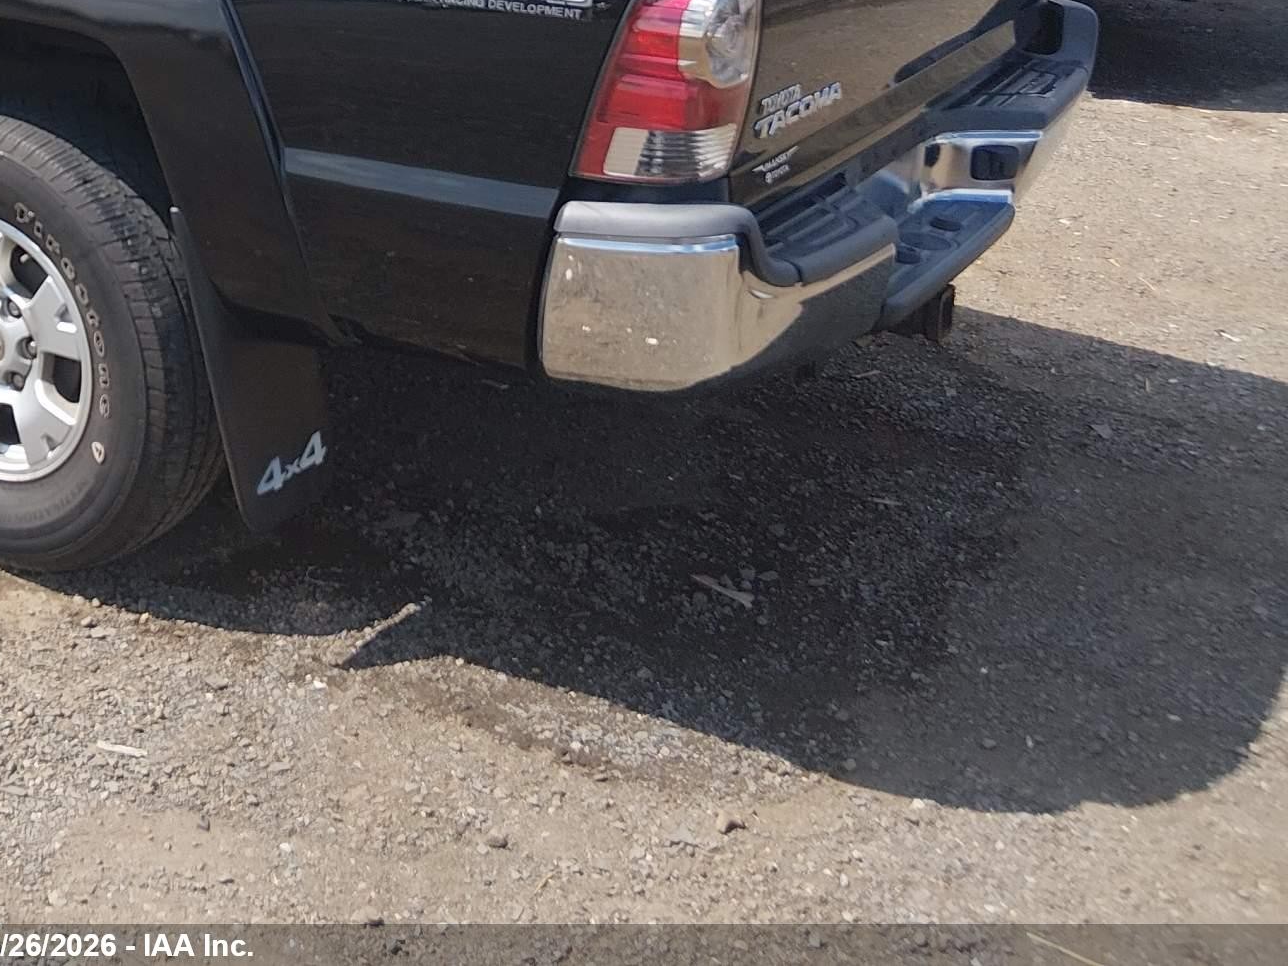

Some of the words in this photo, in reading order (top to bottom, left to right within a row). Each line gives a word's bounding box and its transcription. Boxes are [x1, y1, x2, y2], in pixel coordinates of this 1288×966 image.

[487, 0, 583, 20] DEVELOPMENT
[754, 81, 842, 138] TACOMA
[256, 430, 327, 495] 4x4
